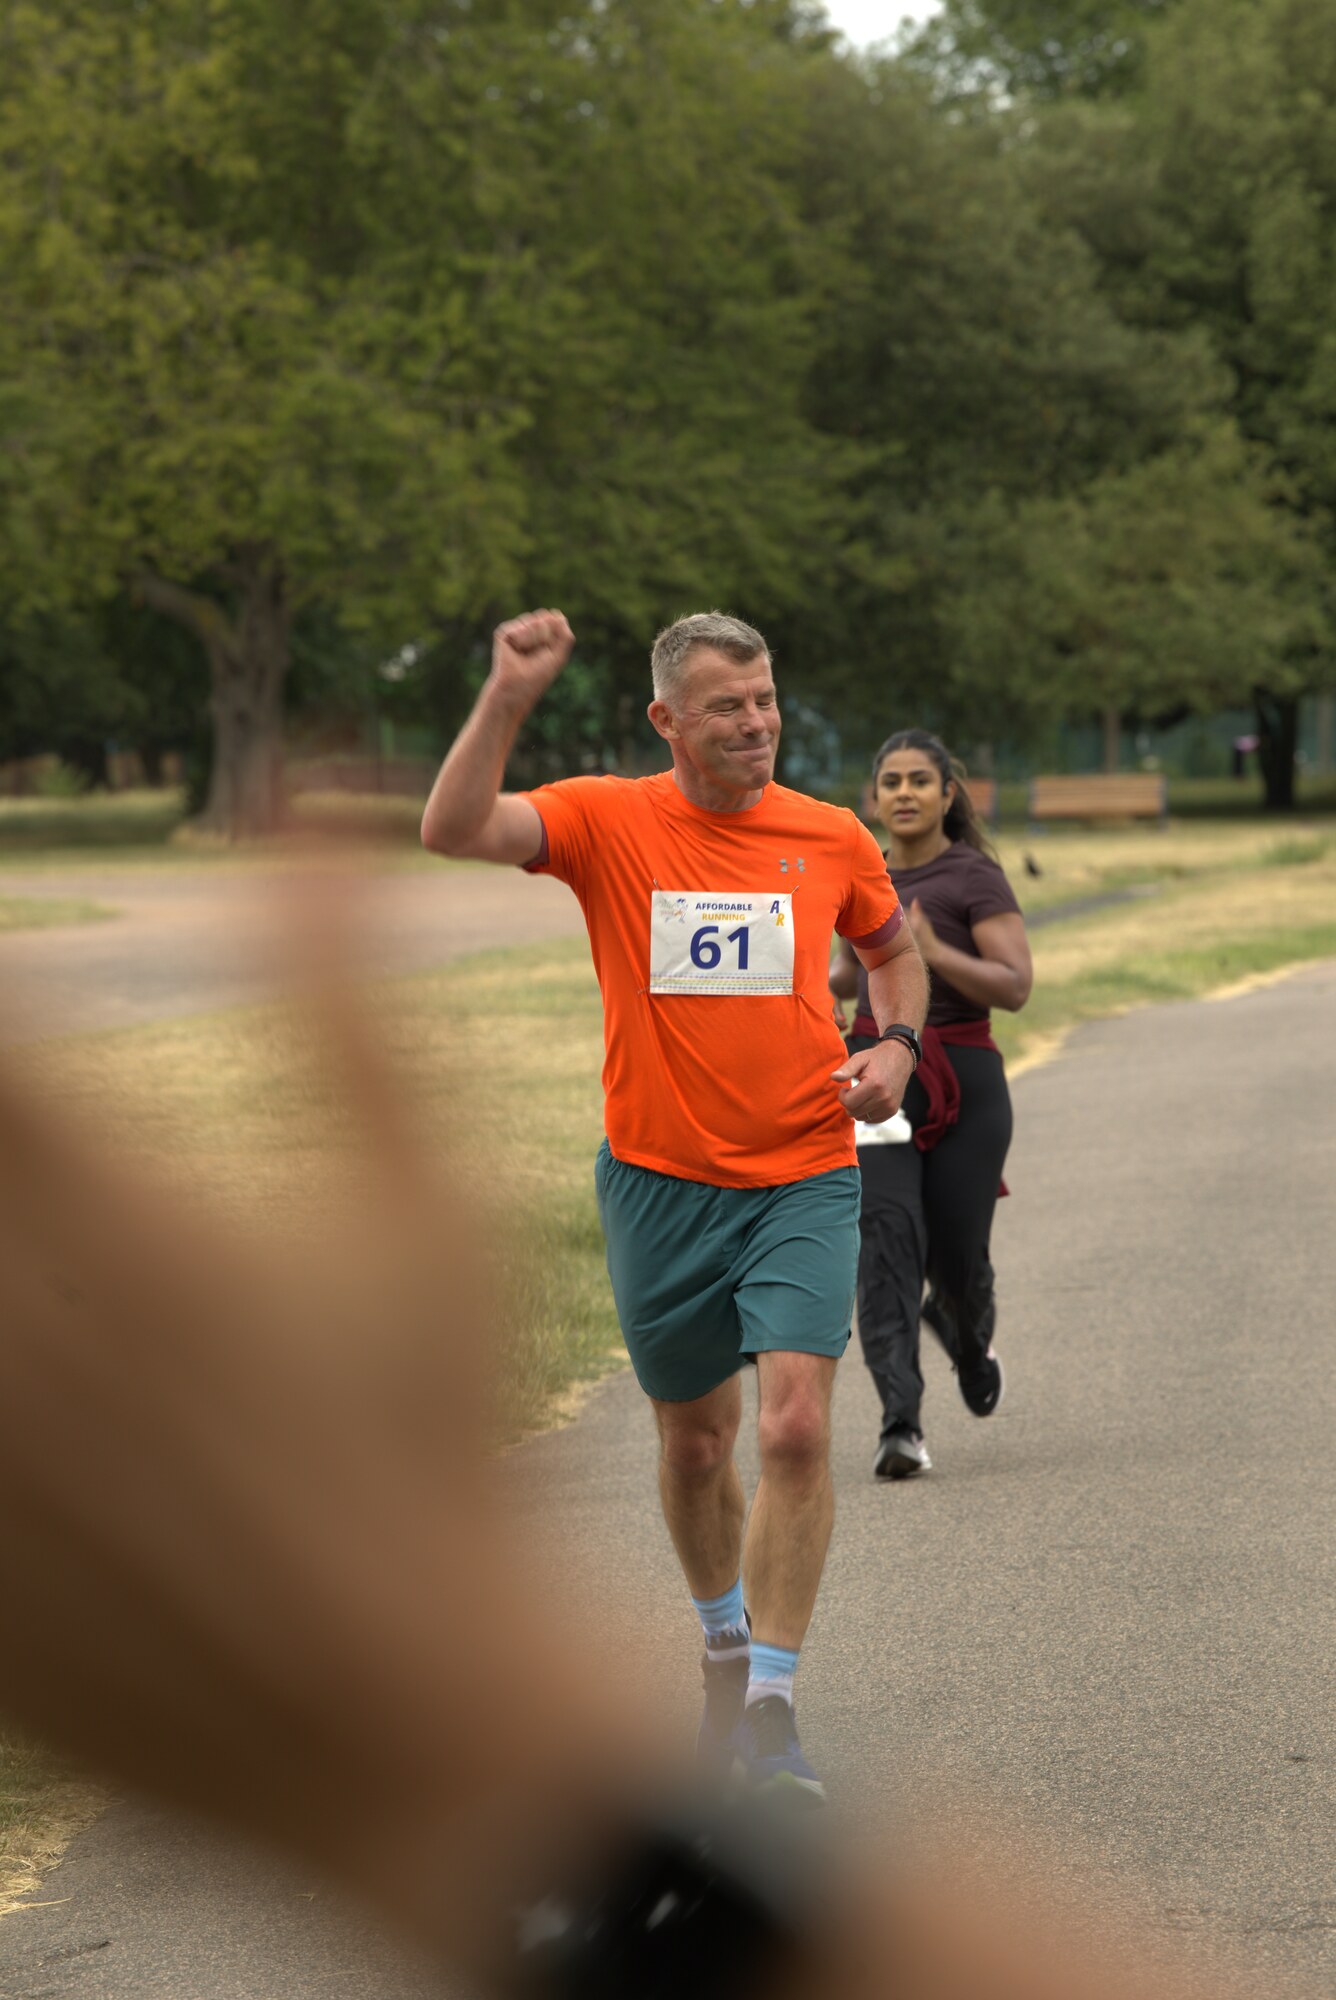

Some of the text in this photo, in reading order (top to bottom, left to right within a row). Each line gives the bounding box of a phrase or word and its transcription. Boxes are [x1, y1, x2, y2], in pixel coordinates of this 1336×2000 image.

[695, 902, 753, 911] AFFORDABLE
[770, 900, 780, 914] A
[702, 913, 746, 921] RUNNING
[776, 913, 785, 926] R
[690, 925, 749, 970] 61
